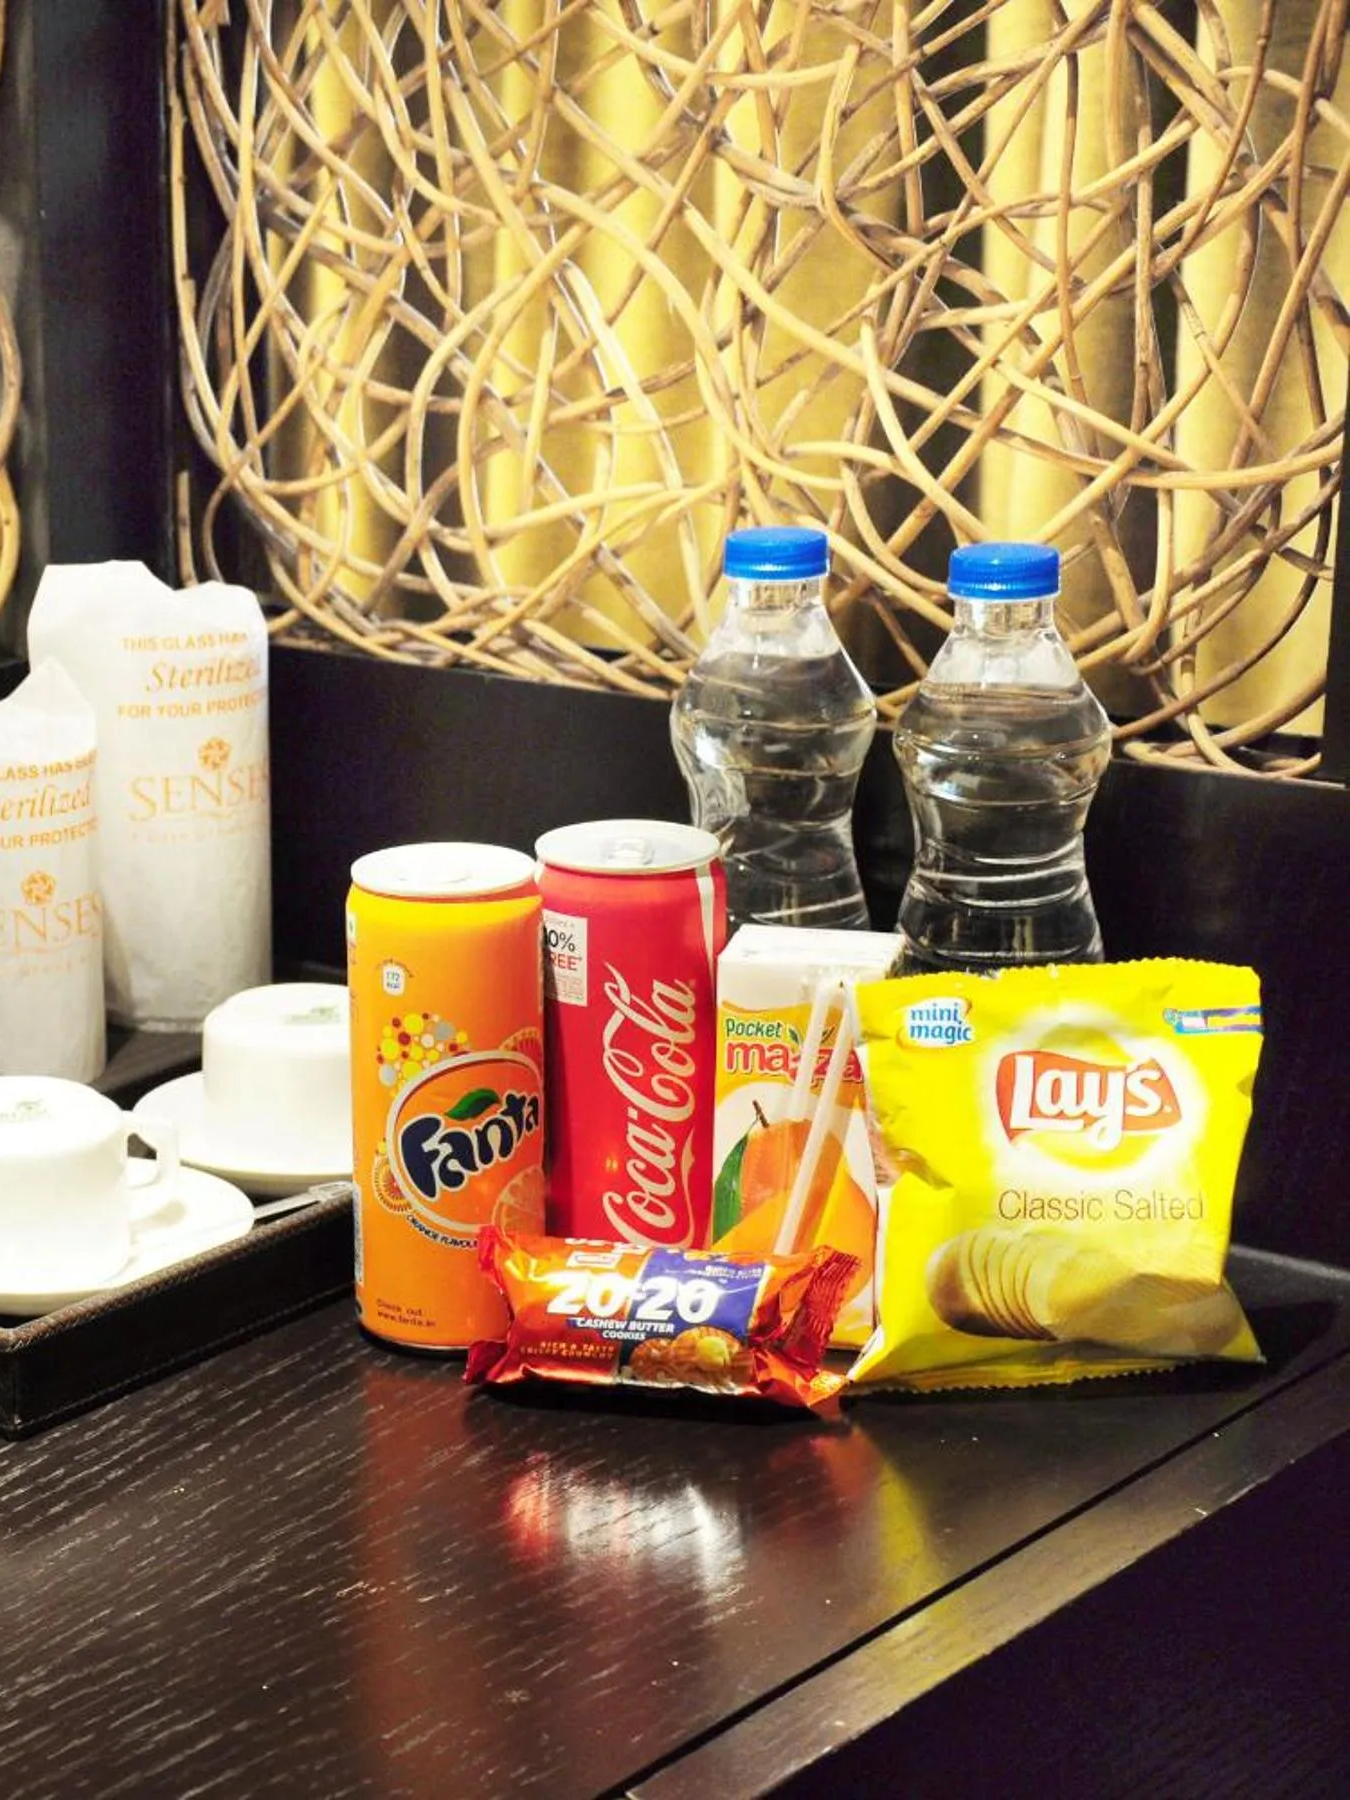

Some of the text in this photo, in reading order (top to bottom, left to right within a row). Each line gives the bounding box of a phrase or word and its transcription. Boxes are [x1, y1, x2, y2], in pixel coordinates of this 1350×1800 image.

[146, 656, 262, 692] Sterilize
[118, 704, 151, 718] FOR
[157, 701, 202, 718] YOUR
[911, 1002, 959, 1021] mini
[726, 1018, 782, 1038] Pocket
[910, 1020, 972, 1045] magic
[400, 1091, 540, 1199] Fanta
[998, 1189, 1204, 1221] Classic Salted
[575, 1317, 675, 1334] CASHEW BUTTER
[602, 1329, 647, 1340] COOKIES
